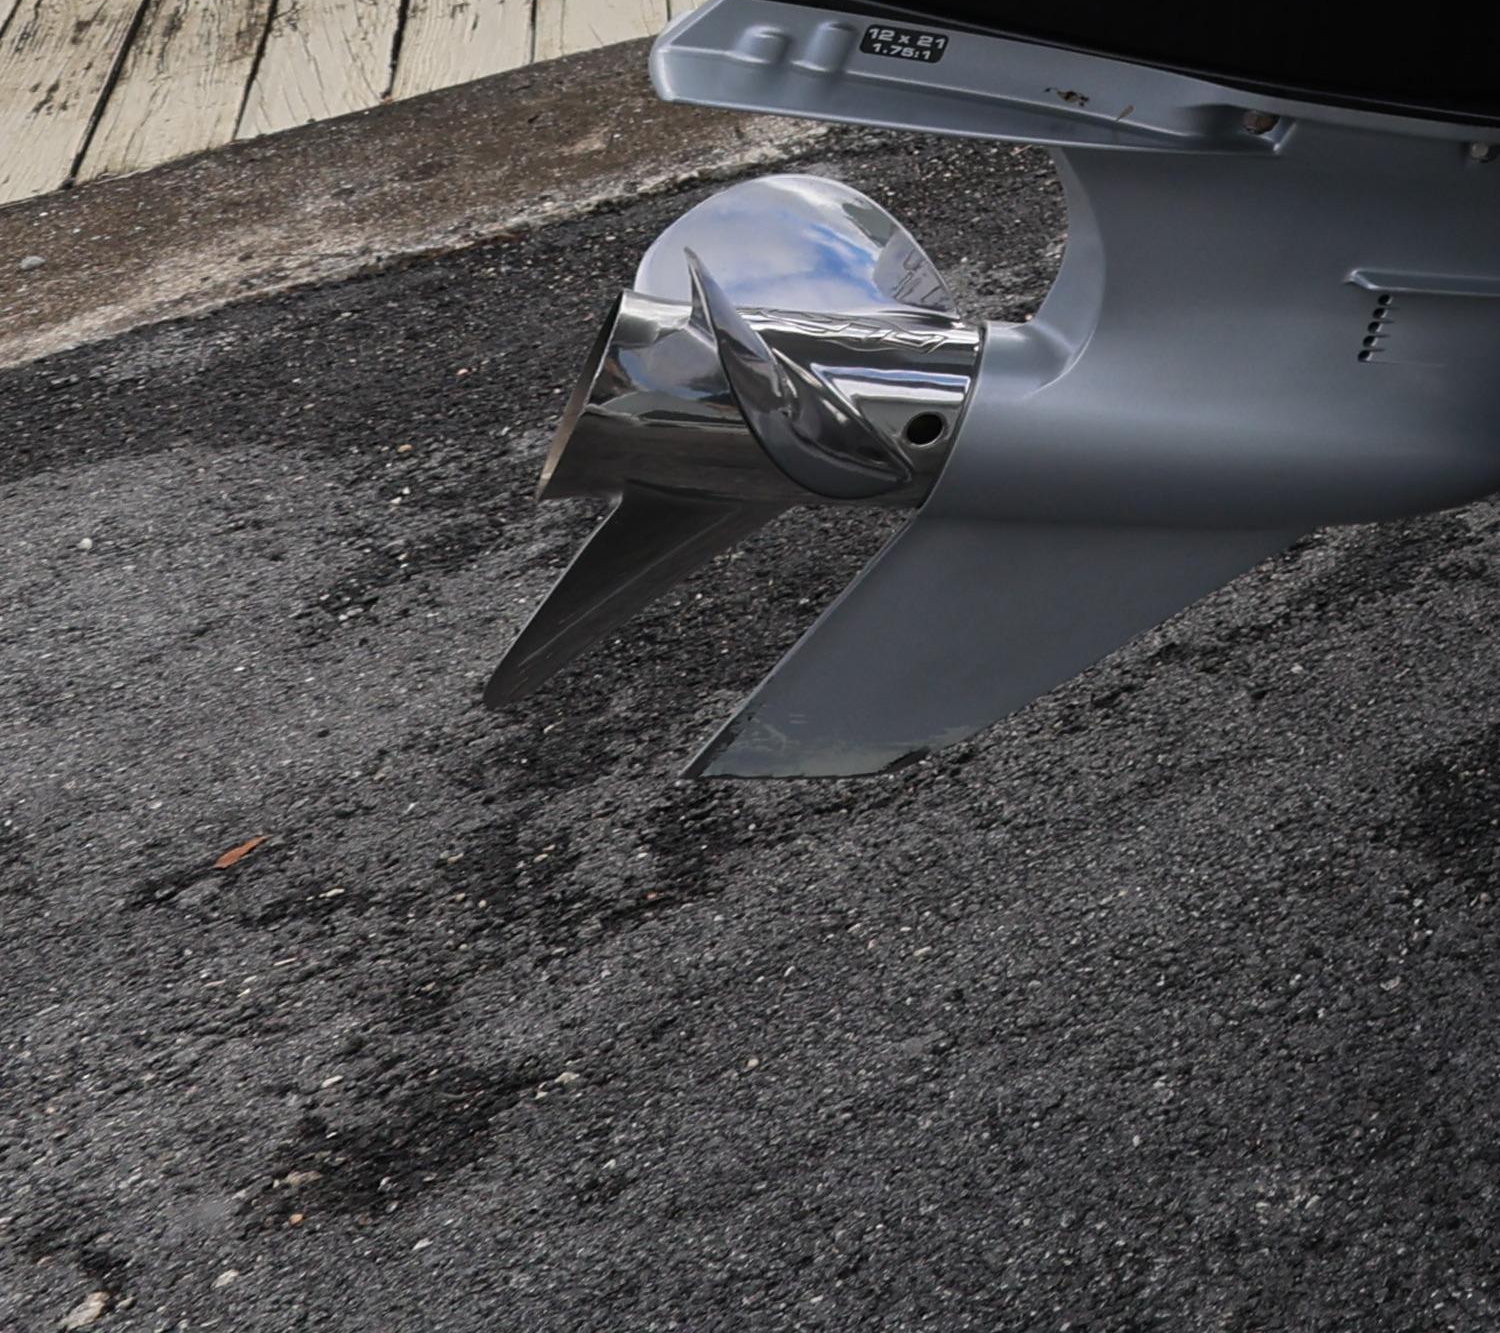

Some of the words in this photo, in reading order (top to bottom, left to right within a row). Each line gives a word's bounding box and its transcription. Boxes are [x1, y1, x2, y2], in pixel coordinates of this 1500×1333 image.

[869, 28, 895, 42] 12
[898, 35, 910, 44] x
[917, 35, 946, 49] 21
